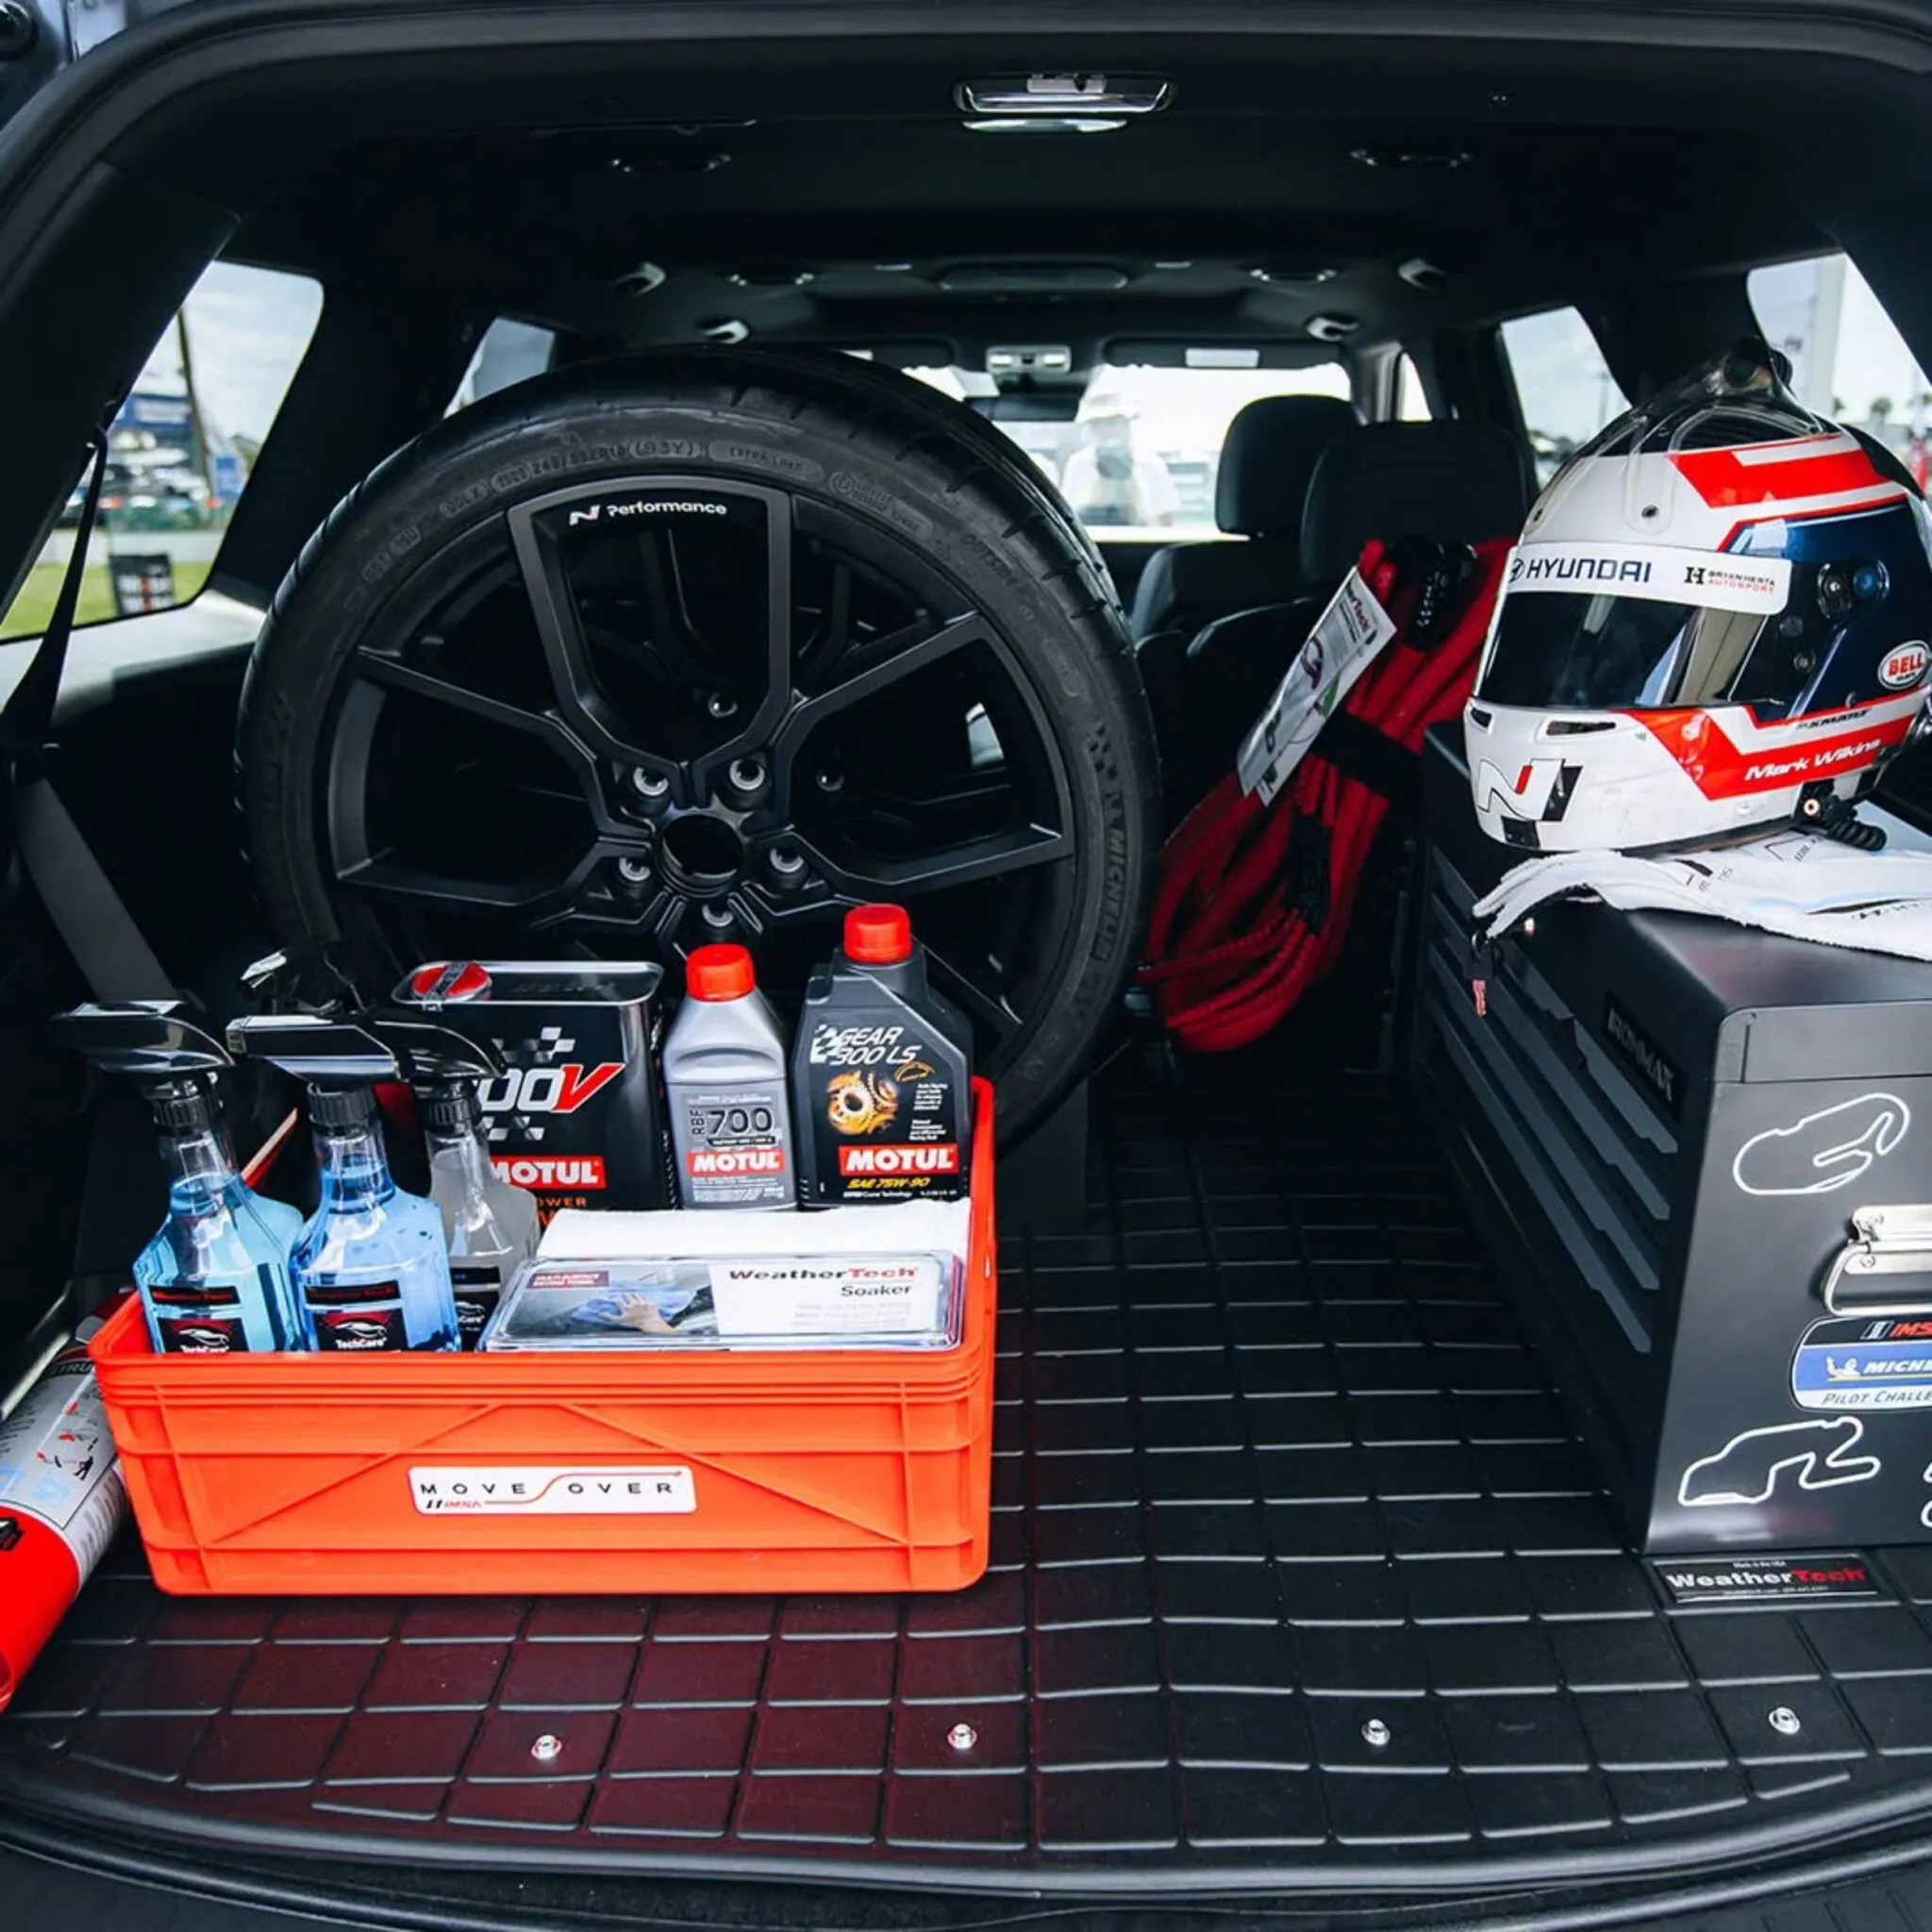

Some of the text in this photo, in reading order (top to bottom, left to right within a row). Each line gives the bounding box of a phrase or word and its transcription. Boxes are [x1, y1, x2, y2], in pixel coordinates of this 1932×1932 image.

[608, 501, 727, 517] Performance
[1526, 558, 1652, 582] HYUNDAI
[1708, 578, 1774, 593] AUTOSPORT
[1889, 652, 1923, 676] BELL
[1745, 739, 1881, 781] Mark Wilkins
[839, 1026, 904, 1046] GEAR
[830, 1045, 922, 1066] 300 LS
[475, 1063, 626, 1113] 00V
[690, 1109, 705, 1135] RBF
[708, 1108, 773, 1134] 700
[693, 1151, 780, 1173] MOTUL
[845, 1149, 953, 1173] MOTUL
[491, 1161, 598, 1184] MOTUL
[729, 1267, 915, 1281] WeatherTech
[841, 1284, 912, 1297] Soaker
[1823, 1392, 1871, 1406] PILOT
[420, 1482, 672, 1494] MOVE OVER
[1666, 1568, 1866, 1588] WeatherTech
